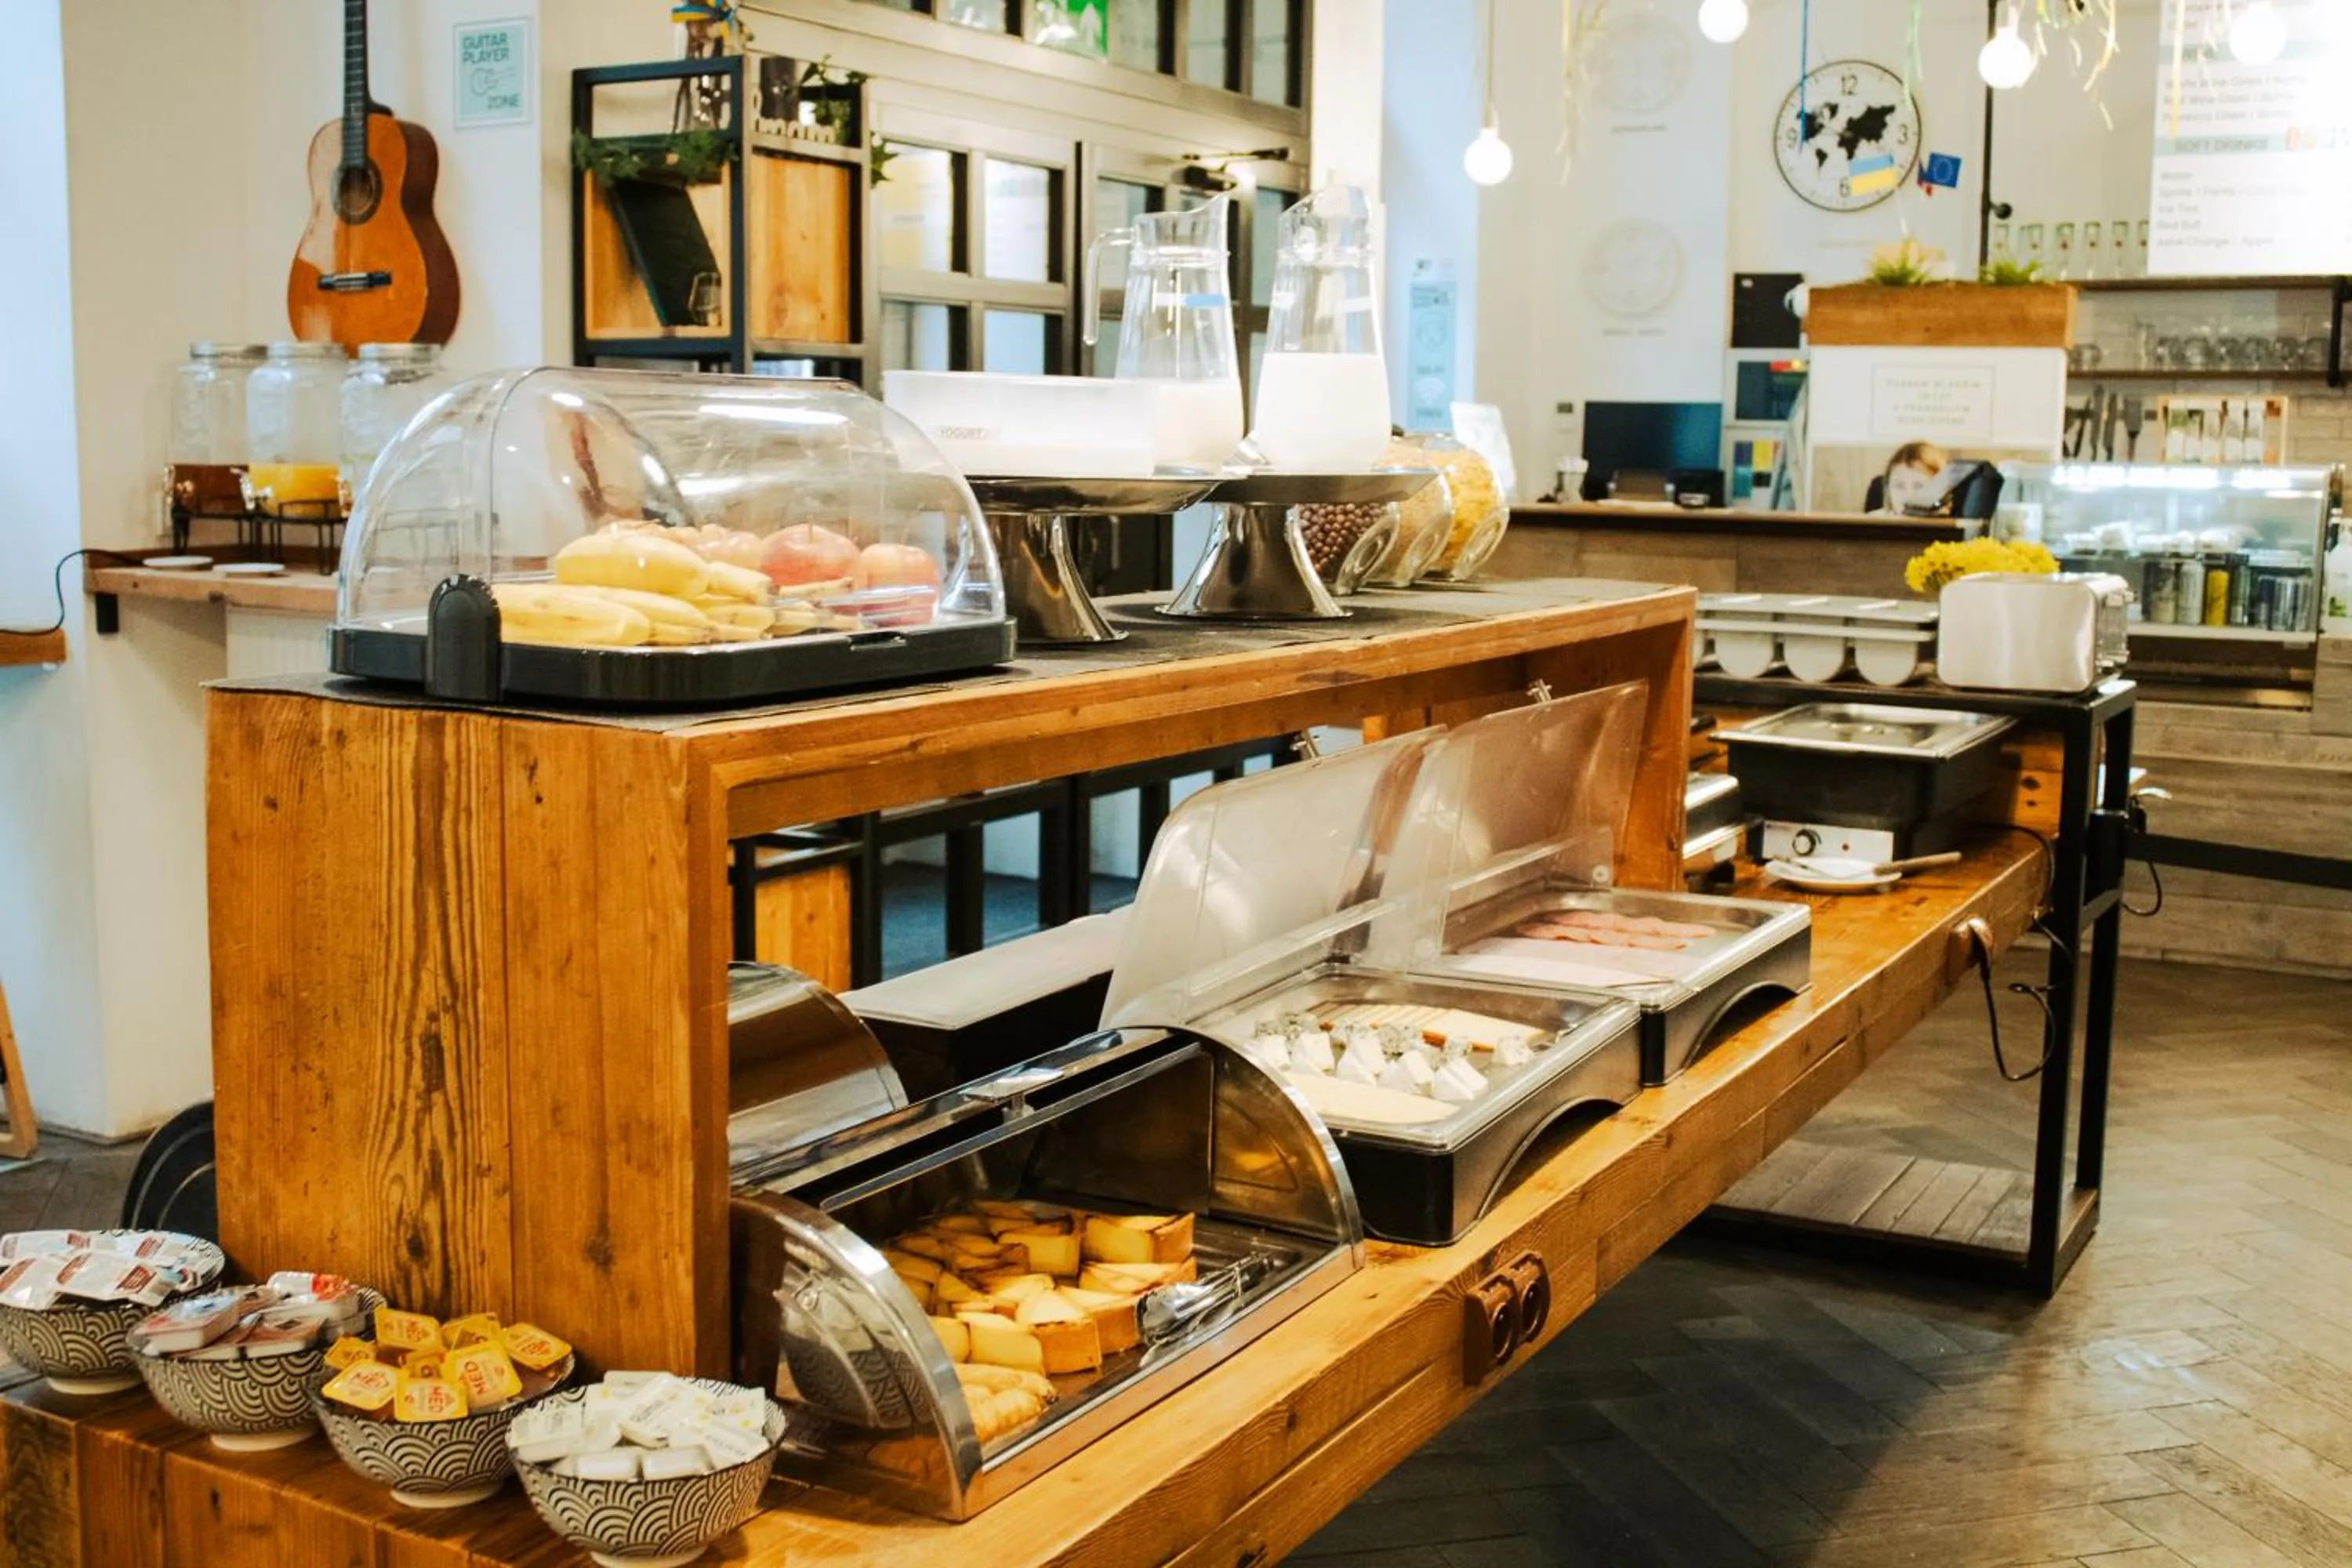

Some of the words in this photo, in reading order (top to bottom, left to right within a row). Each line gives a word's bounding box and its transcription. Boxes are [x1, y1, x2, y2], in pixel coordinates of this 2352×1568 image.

[463, 33, 508, 49] GUITAR
[463, 48, 510, 64] PLAYER
[1841, 74, 1858, 96] 12
[487, 93, 520, 109] ZONE
[1896, 123, 1909, 145] 3
[463, 1360, 487, 1395] MED
[428, 1385, 445, 1412] MED
